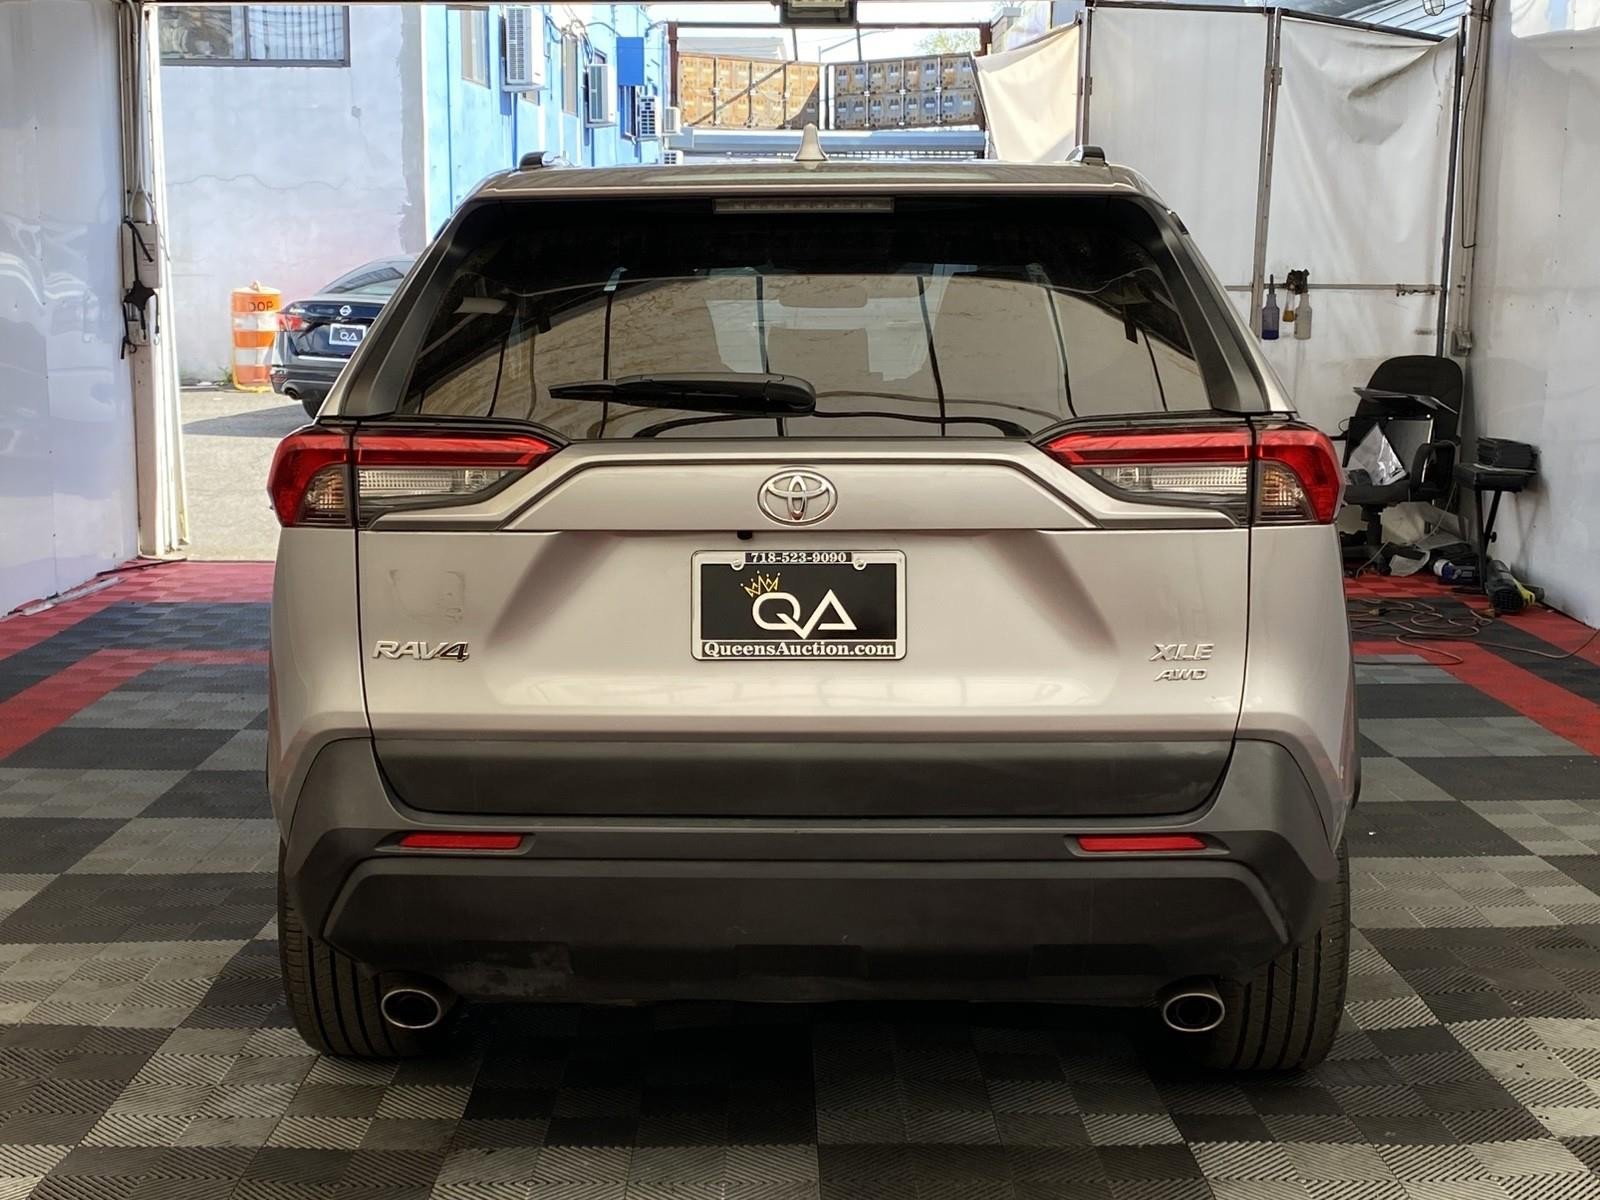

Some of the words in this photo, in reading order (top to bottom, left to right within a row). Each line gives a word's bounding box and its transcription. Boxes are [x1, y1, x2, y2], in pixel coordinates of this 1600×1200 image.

[750, 552, 847, 563] 718-523-9090
[752, 588, 858, 639] QA
[372, 640, 470, 662] RAV4
[704, 641, 895, 657] QueensAuction.com
[1149, 643, 1215, 661] XLE
[1153, 668, 1208, 681] AWD
